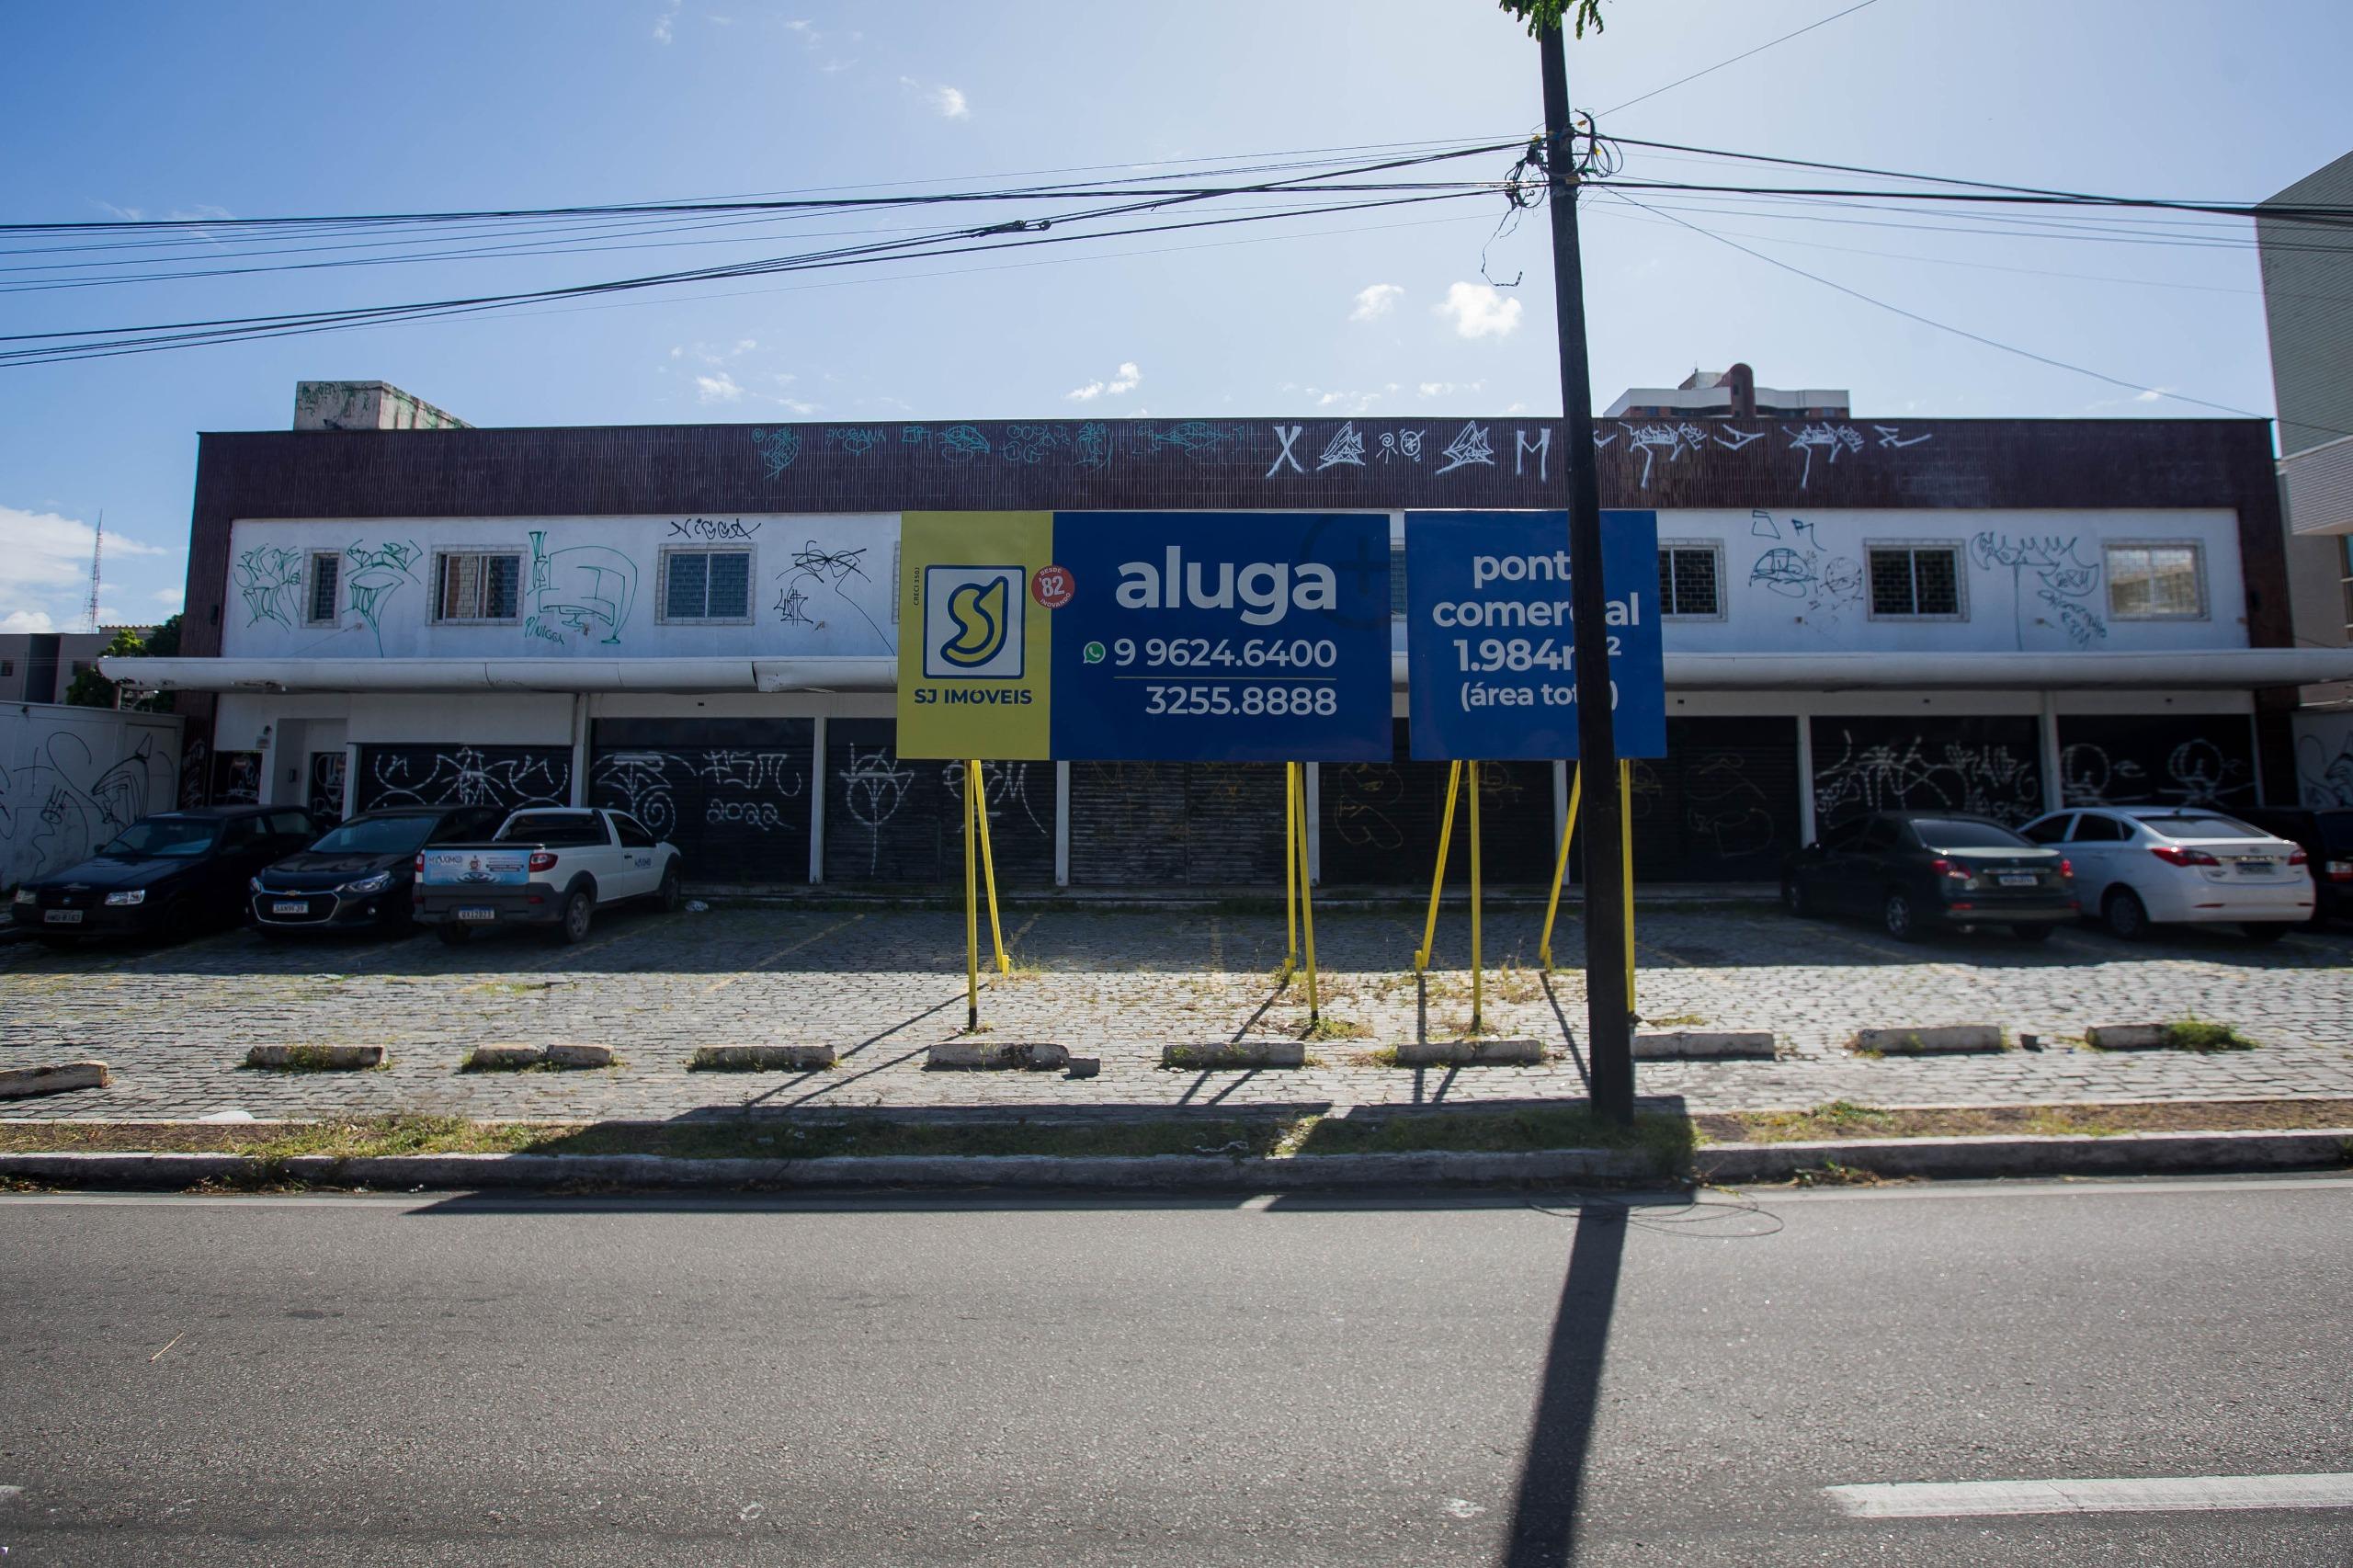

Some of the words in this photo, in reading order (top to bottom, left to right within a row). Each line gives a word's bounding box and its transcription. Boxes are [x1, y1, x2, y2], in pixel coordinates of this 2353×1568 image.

[1040, 567, 1063, 576] DESDE
[1473, 551, 1572, 588] pont
[1040, 592, 1071, 608] INOVANDO
[1115, 545, 1336, 626] aluga
[1432, 592, 1640, 627] comeral
[1113, 638, 1136, 666] 9
[1145, 639, 1337, 667] 9624.6400
[915, 688, 938, 705] SJ
[1145, 686, 1337, 715] 3255.8888
[1461, 681, 1533, 711] (área
